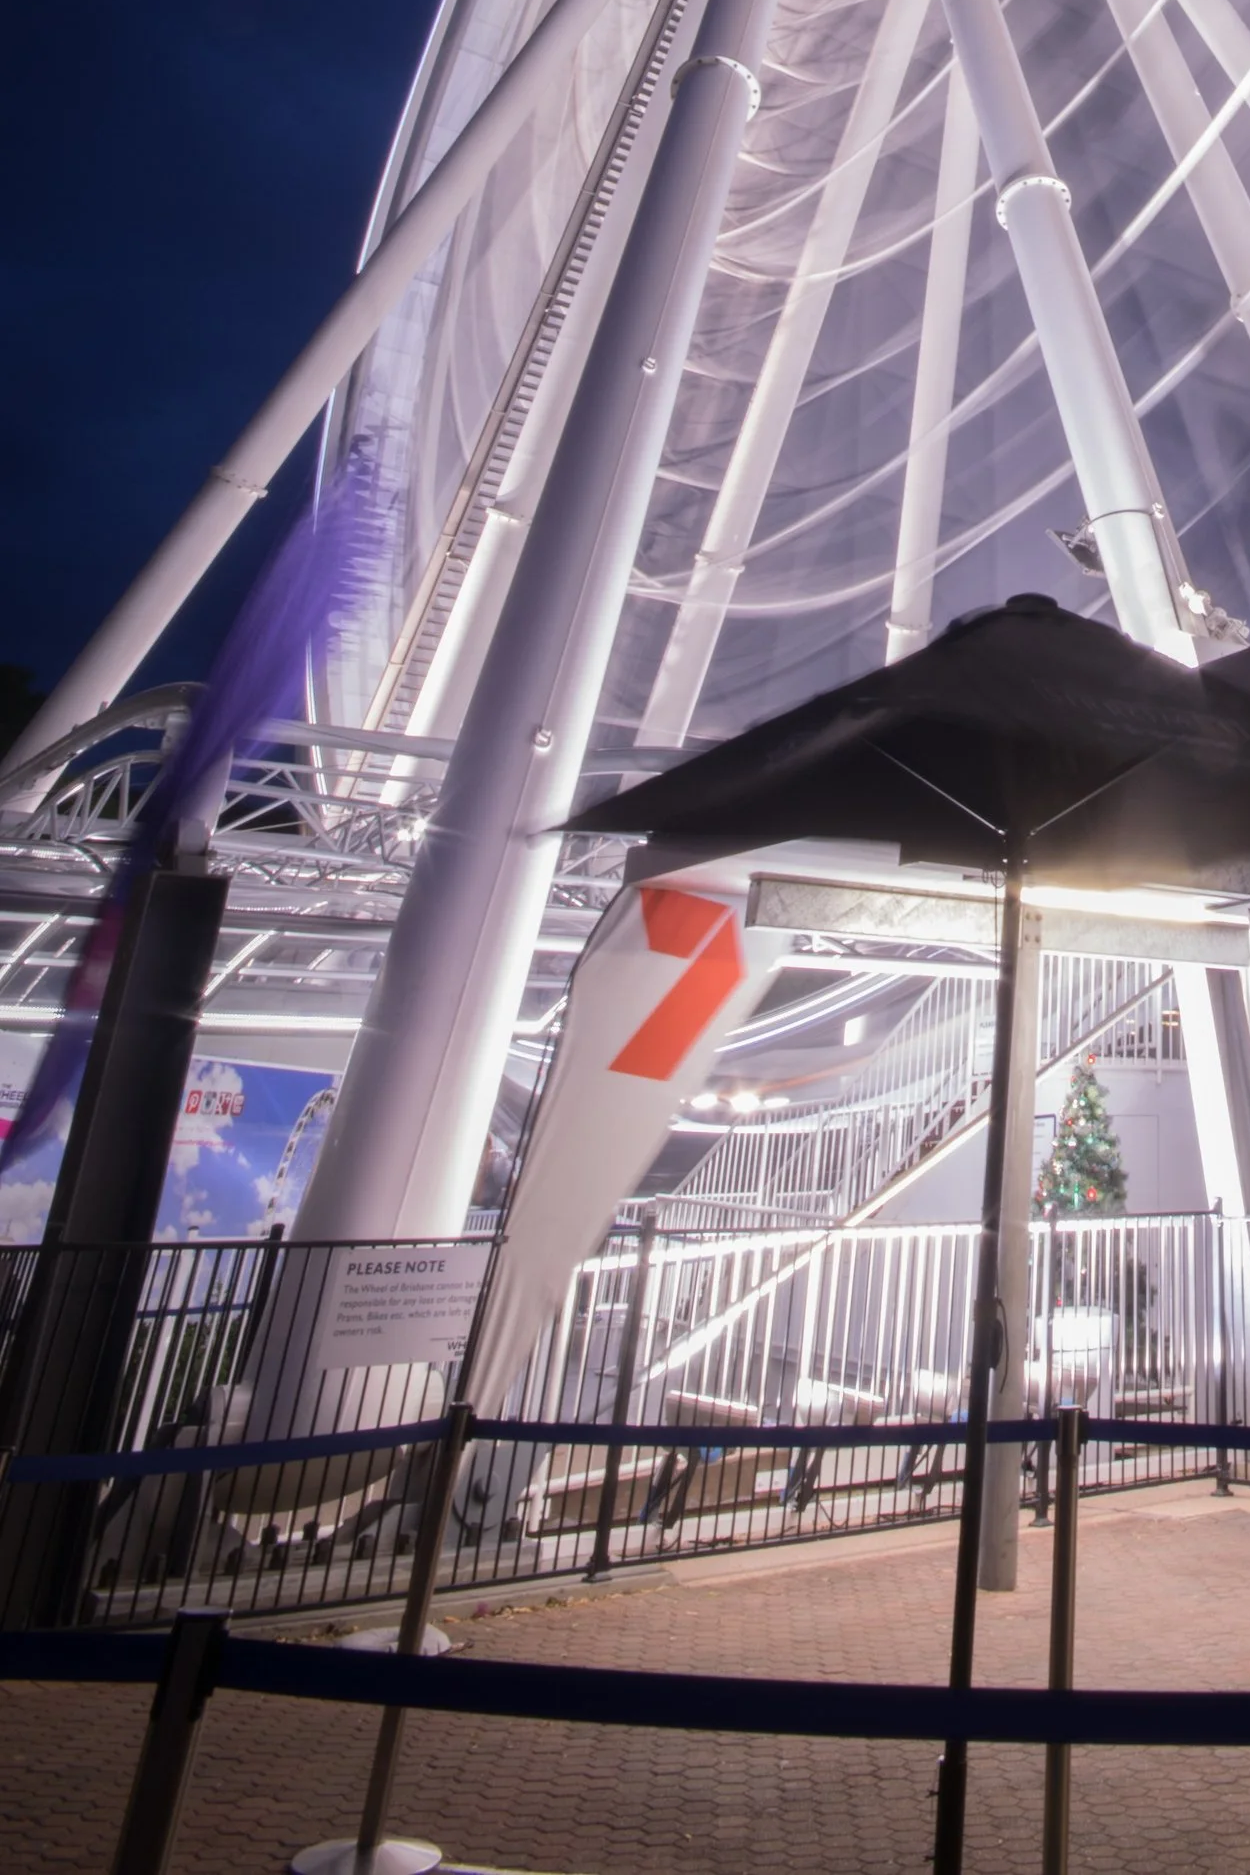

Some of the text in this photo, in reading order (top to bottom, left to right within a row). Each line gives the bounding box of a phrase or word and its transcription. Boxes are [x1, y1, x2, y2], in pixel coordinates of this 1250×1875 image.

[347, 1260, 446, 1275] PLEASE NOTE
[344, 1284, 359, 1294] The
[361, 1283, 388, 1293] Wheel
[390, 1283, 399, 1292] of
[400, 1282, 435, 1292] Brisbane
[339, 1297, 387, 1309] responsible
[388, 1296, 401, 1306] for
[402, 1298, 416, 1308] any
[367, 1310, 388, 1322] Bikes
[408, 1308, 431, 1319] which
[433, 1309, 446, 1318] are
[333, 1328, 364, 1337] owners
